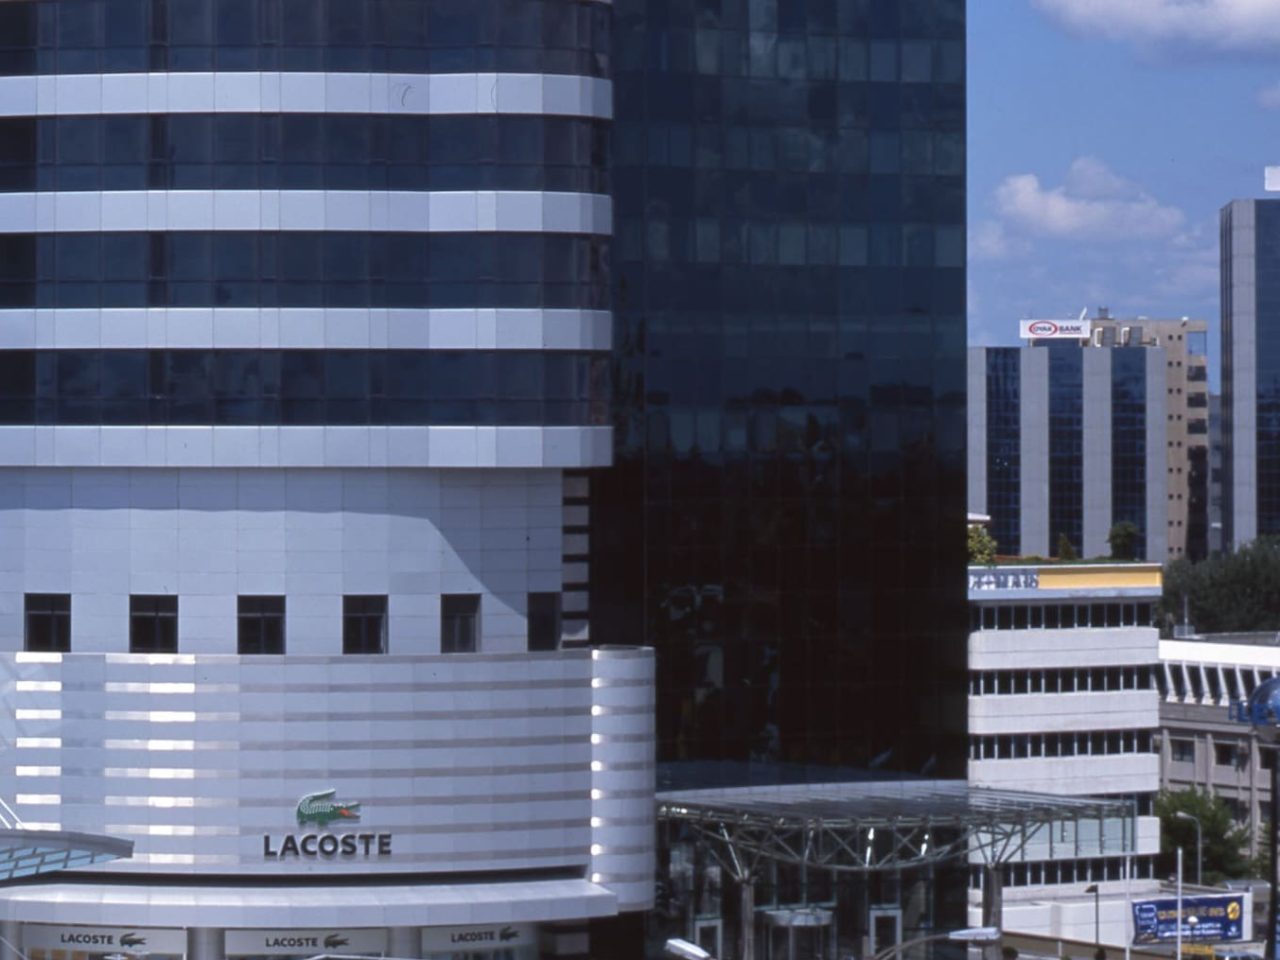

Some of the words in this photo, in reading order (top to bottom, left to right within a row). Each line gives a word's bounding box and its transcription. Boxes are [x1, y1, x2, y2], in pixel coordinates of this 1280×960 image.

[263, 833, 393, 857] LACOSTE
[60, 933, 114, 945] LACOSTE
[265, 936, 319, 948] LACOSTE
[450, 931, 496, 943] LACOSTE
